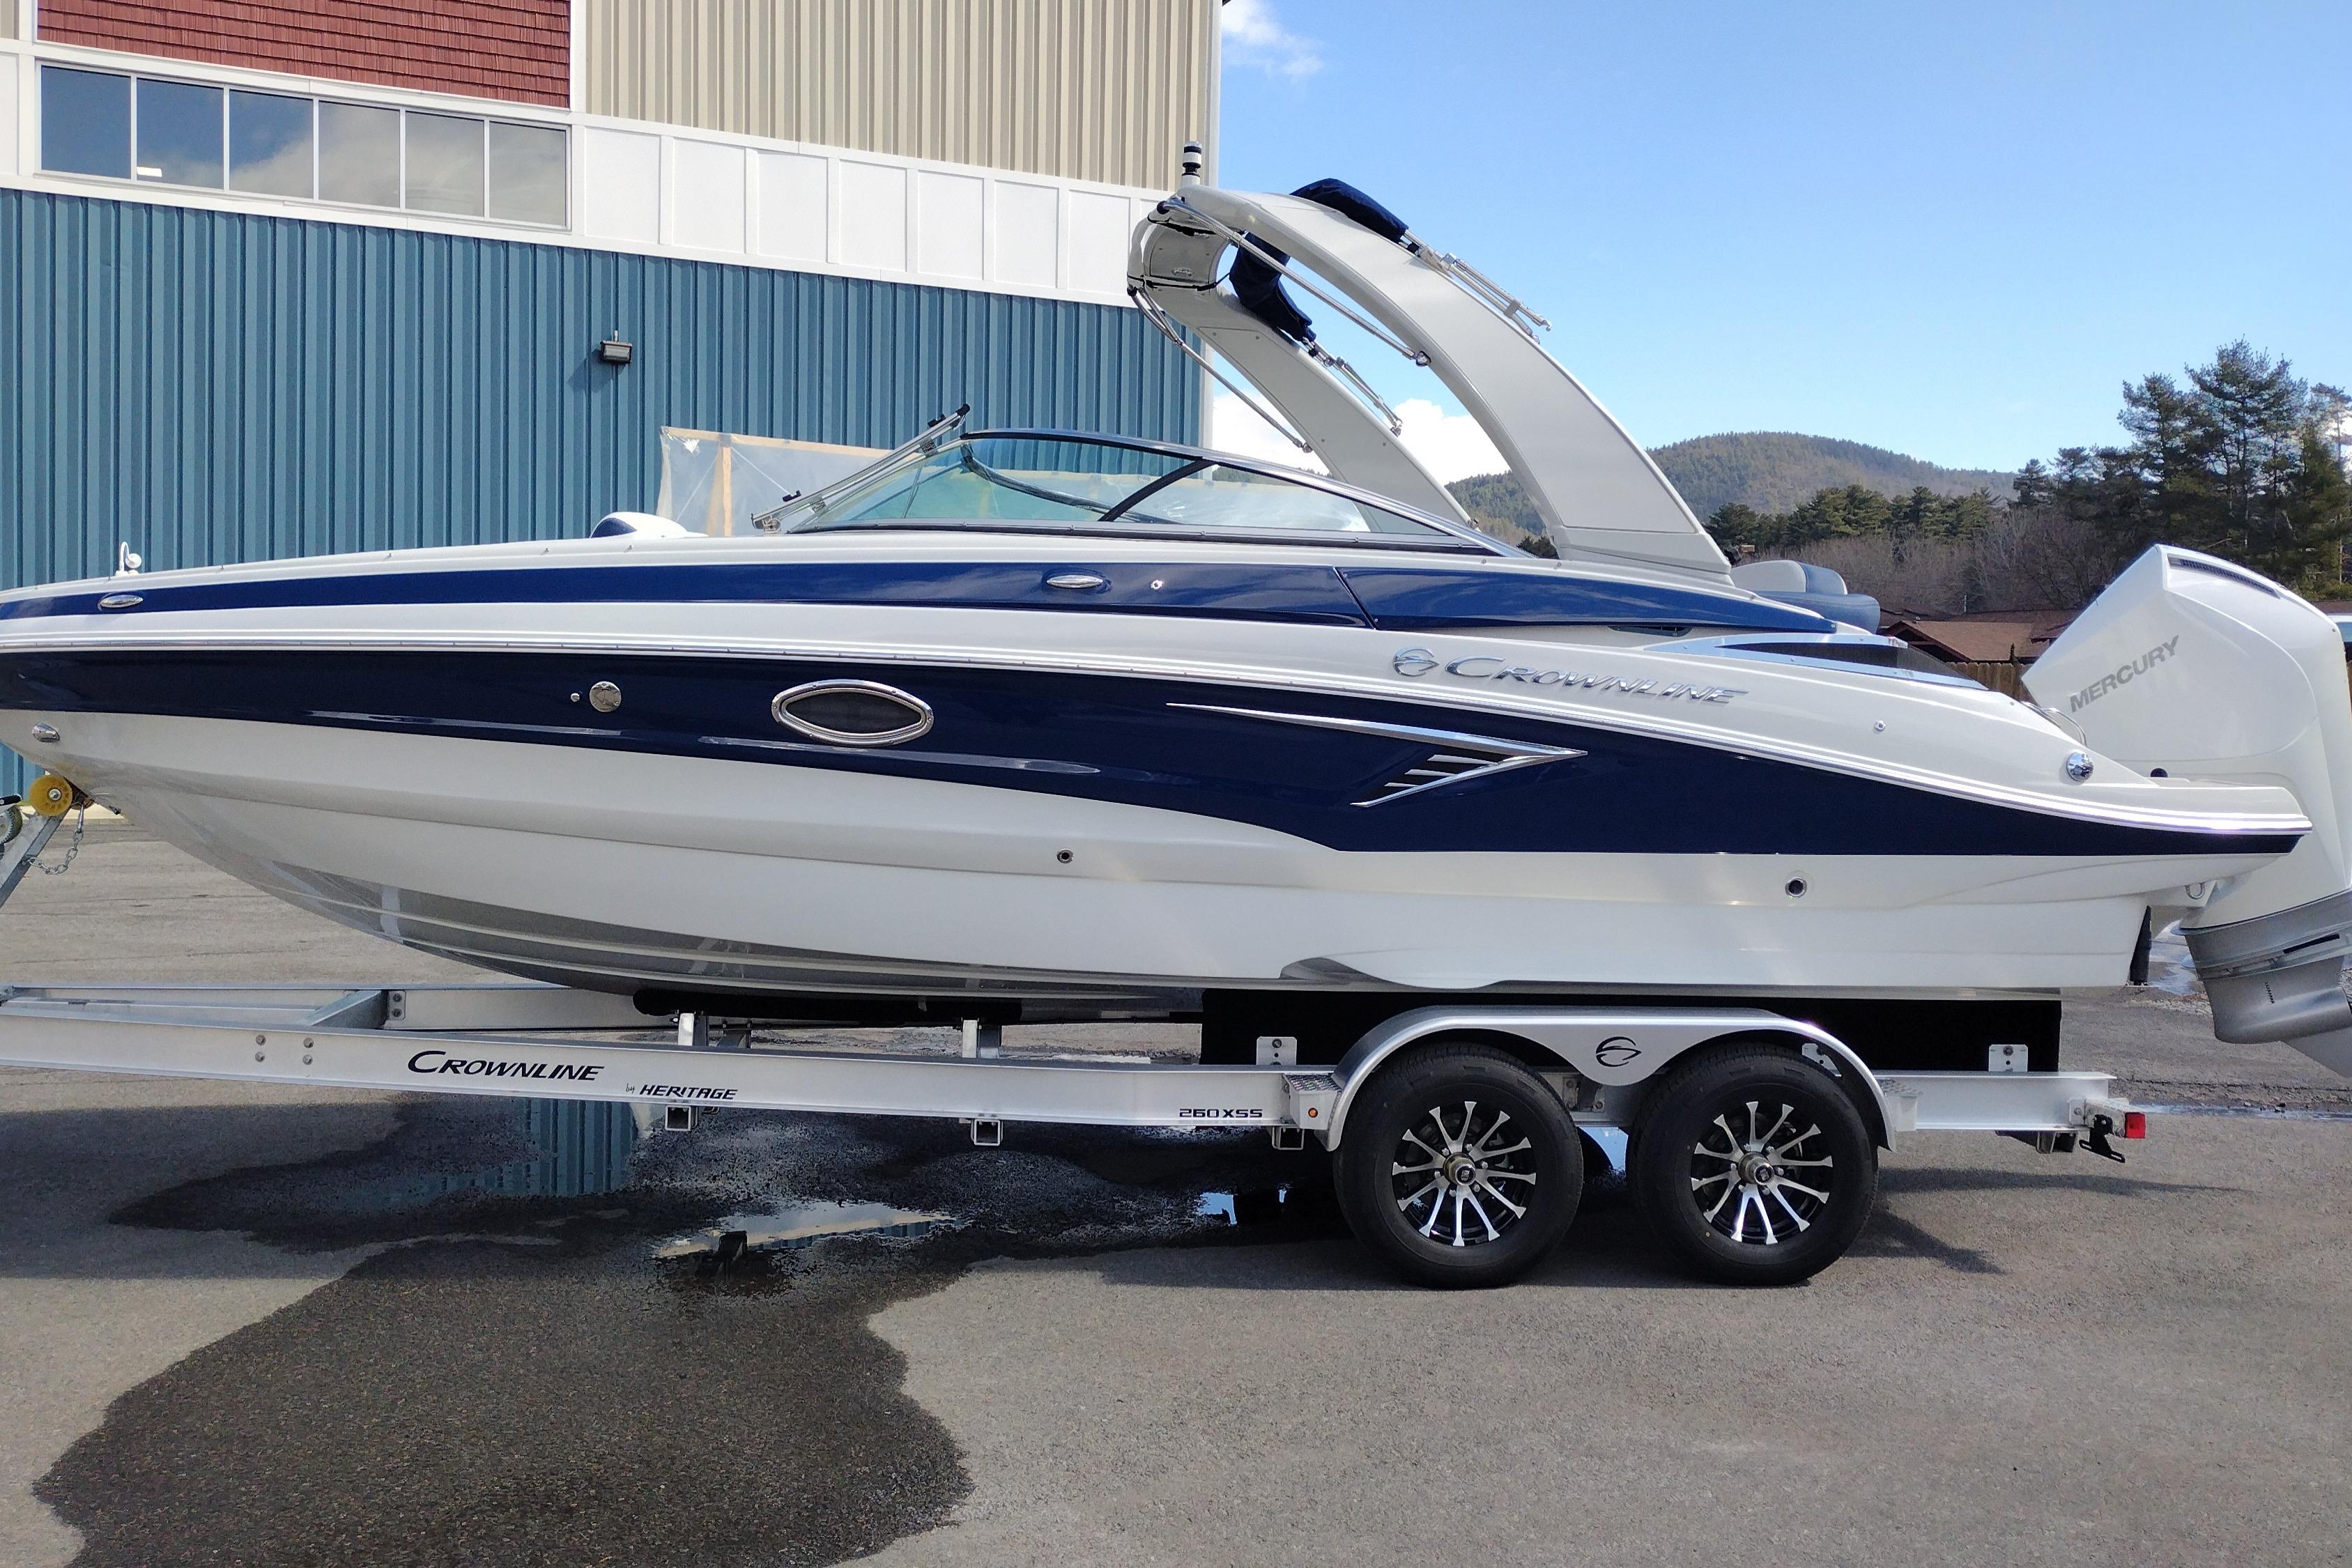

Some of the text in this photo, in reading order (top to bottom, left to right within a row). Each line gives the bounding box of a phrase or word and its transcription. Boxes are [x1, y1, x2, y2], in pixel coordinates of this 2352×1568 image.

[1444, 656, 1749, 705] CROWNLINE
[2069, 635, 2179, 713] MERCURY
[407, 1050, 605, 1081] CROWNLINE
[626, 1083, 738, 1100] by HERITAGE
